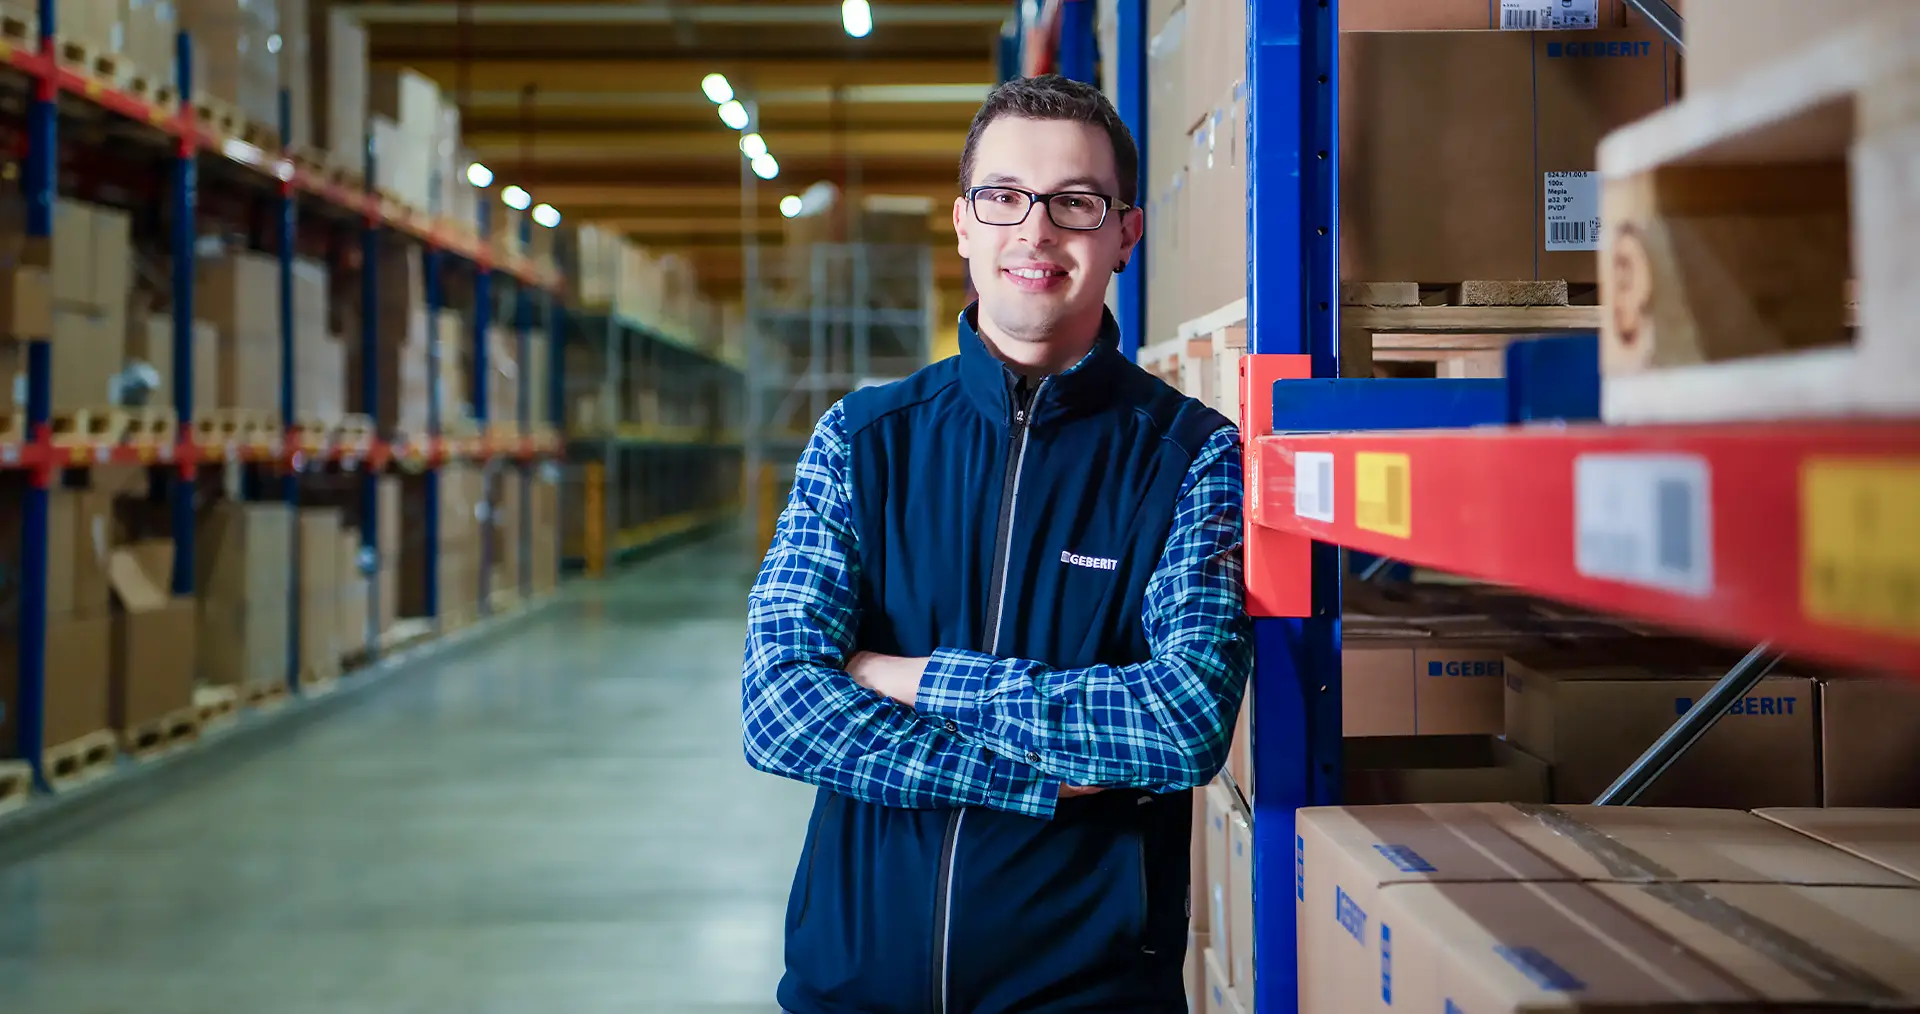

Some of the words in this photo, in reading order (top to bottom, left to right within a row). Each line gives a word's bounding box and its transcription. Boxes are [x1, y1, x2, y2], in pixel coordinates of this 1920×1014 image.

[1565, 41, 1651, 57] GEBERIT
[1070, 554, 1118, 570] GEBERIT
[1446, 661, 1504, 677] GEBE
